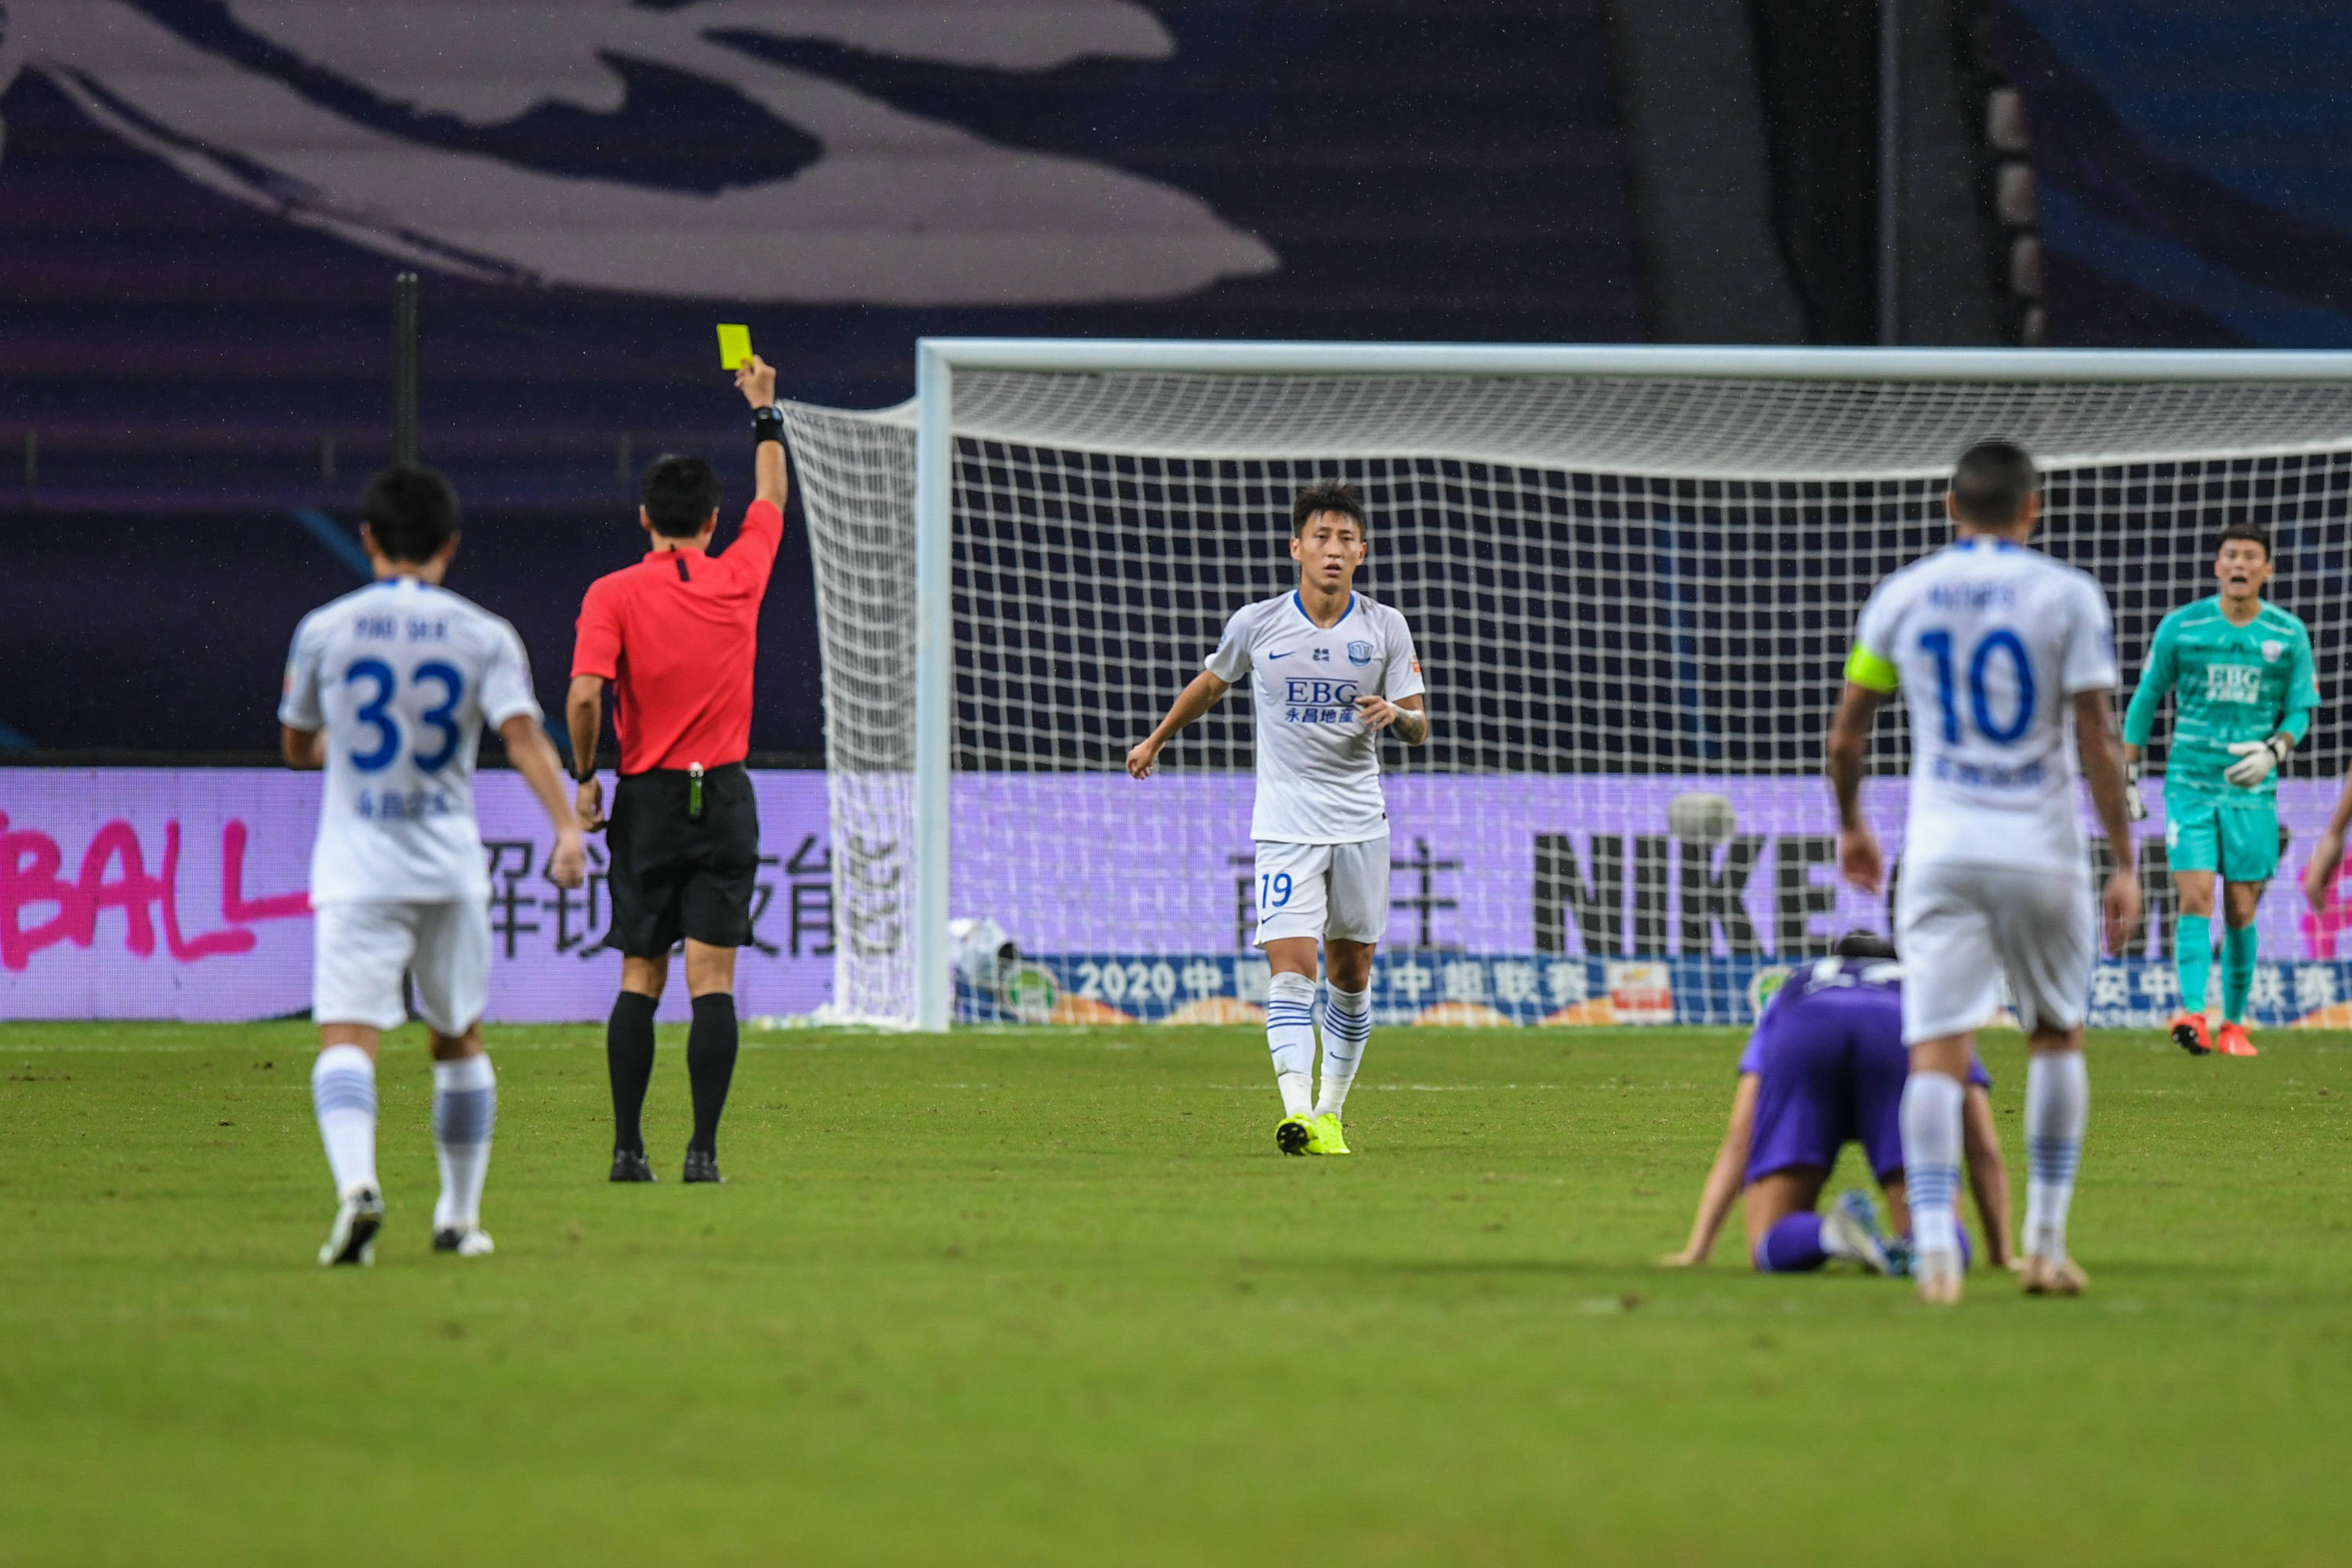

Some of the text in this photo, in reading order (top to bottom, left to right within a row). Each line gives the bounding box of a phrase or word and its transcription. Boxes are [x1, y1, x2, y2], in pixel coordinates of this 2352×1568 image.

[345, 659, 464, 771] 33
[1285, 680, 1358, 706] EBG
[1919, 630, 2034, 744] 10
[1261, 873, 1293, 909] 19
[1534, 833, 1837, 957] NIKE
